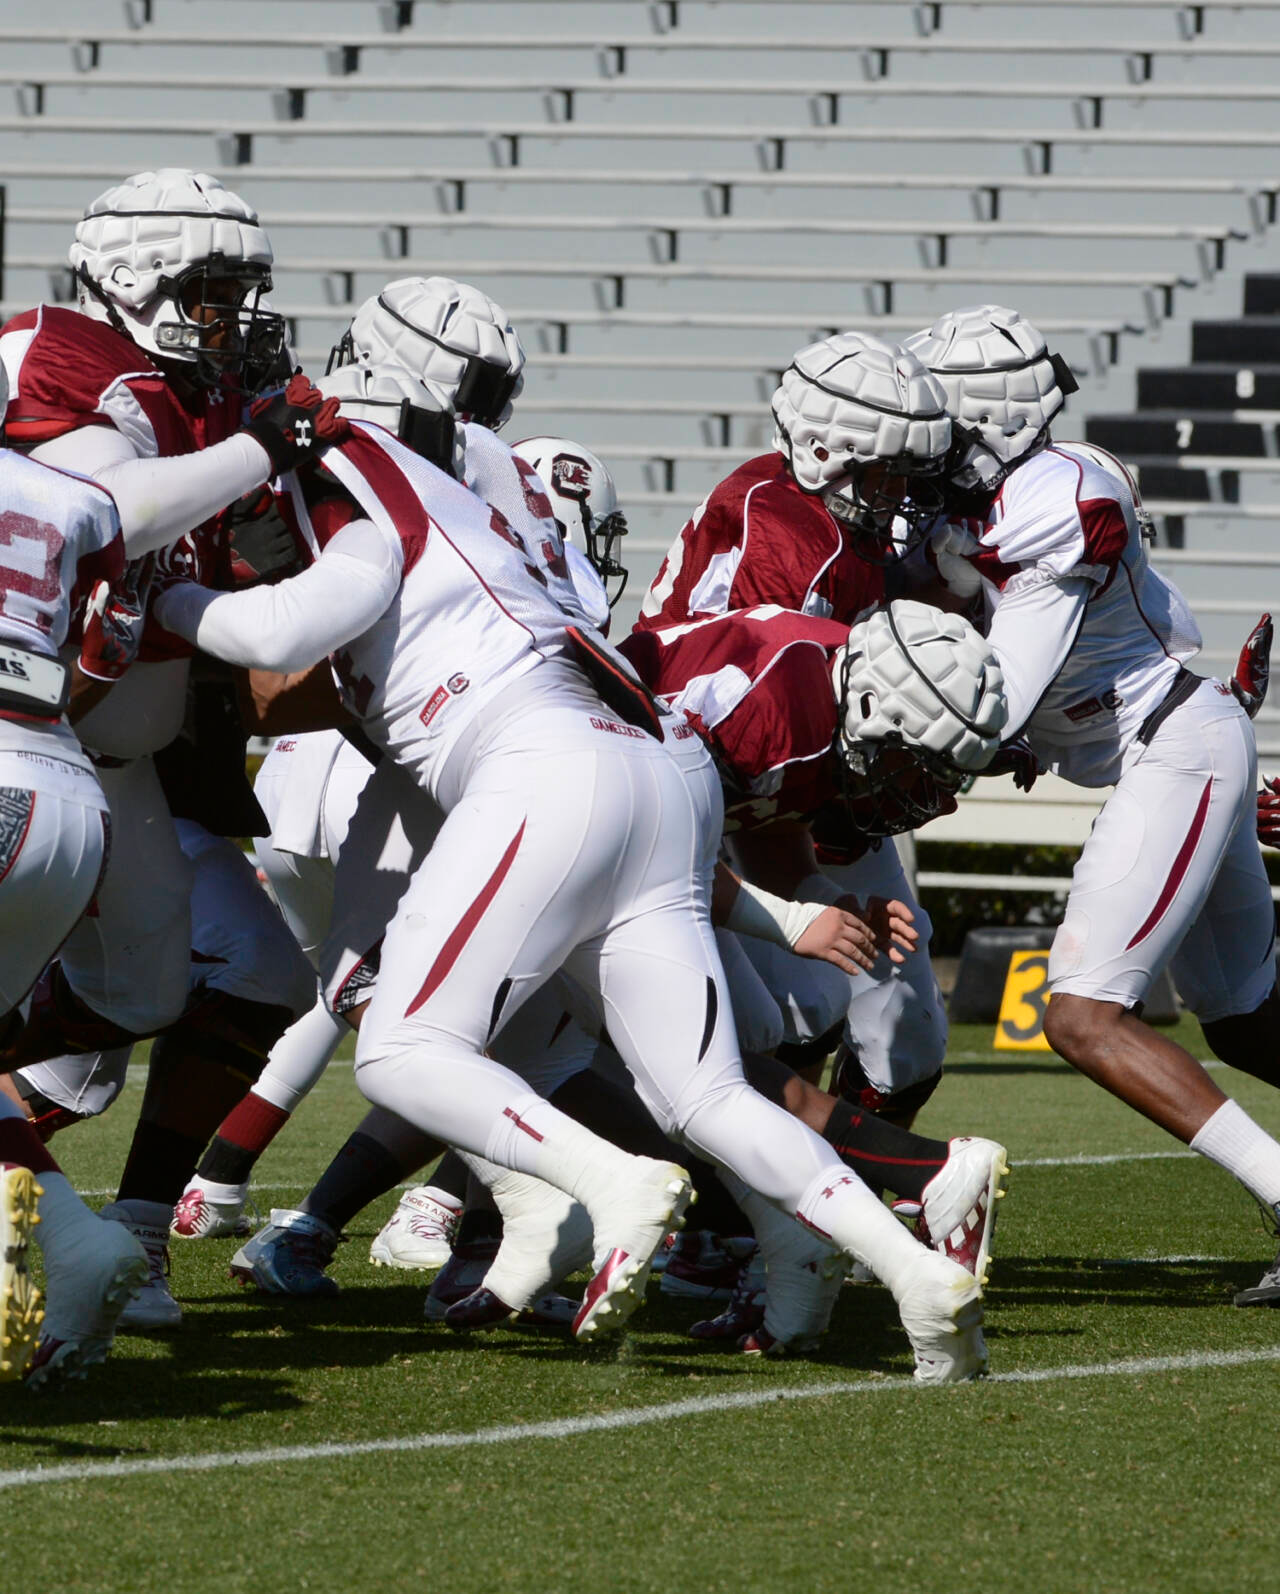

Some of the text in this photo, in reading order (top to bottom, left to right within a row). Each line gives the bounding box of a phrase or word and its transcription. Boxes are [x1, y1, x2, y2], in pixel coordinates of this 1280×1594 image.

[1235, 368, 1255, 398] 8
[1175, 419, 1193, 448] 7
[1001, 956, 1051, 1042] 3
